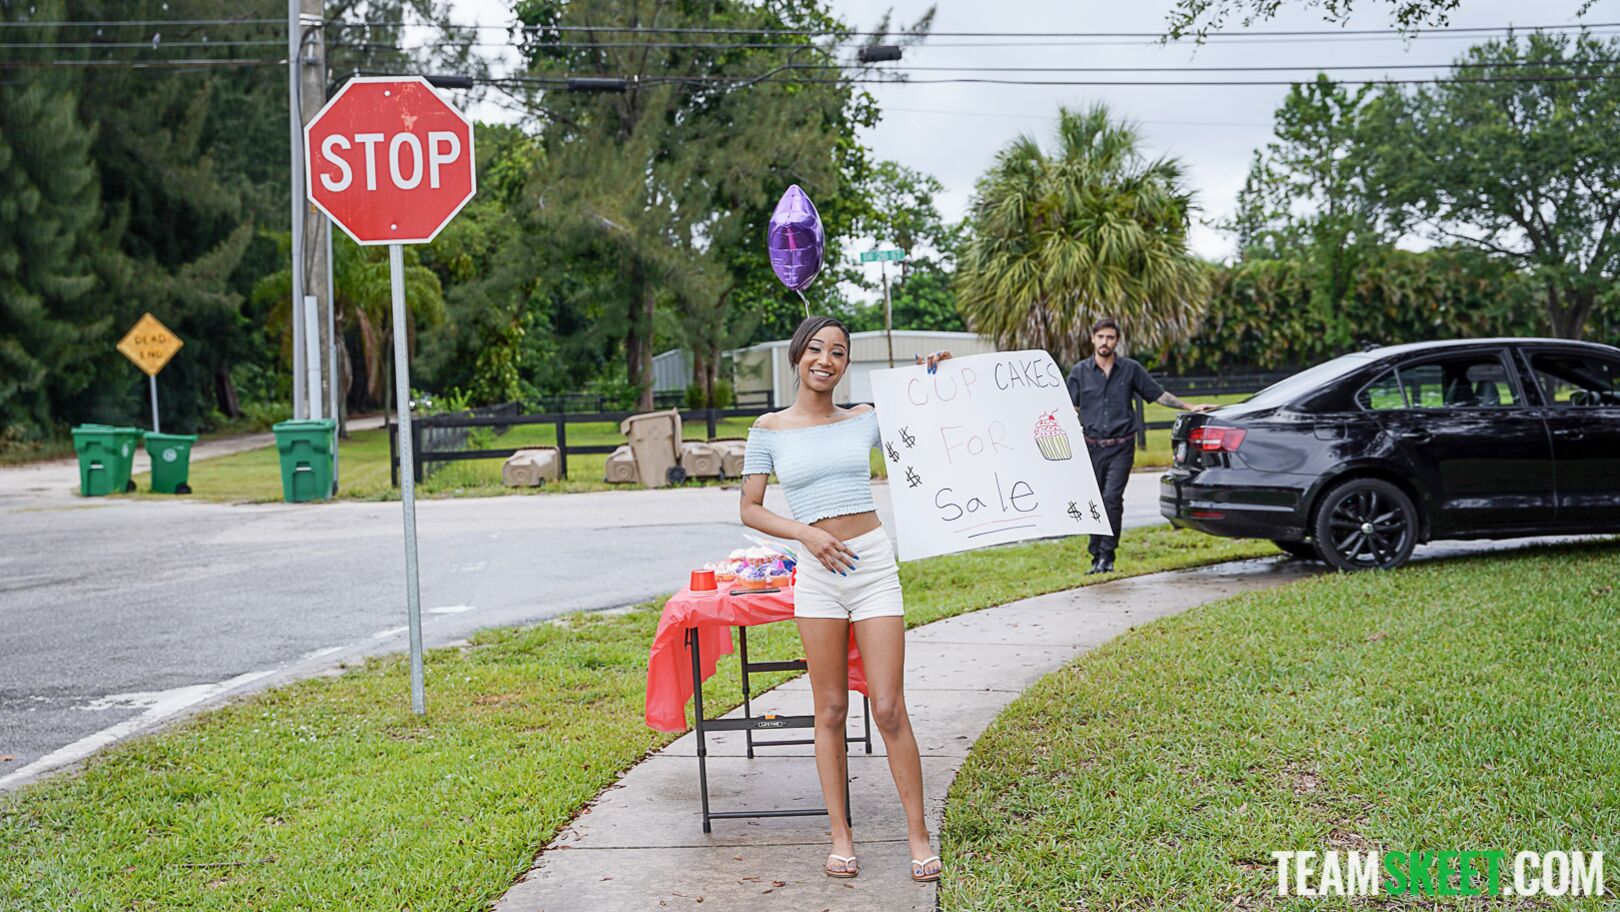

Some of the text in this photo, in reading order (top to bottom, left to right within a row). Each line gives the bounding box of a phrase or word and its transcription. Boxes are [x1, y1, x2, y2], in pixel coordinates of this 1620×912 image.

[320, 131, 461, 192] STOP
[134, 333, 166, 345] DEAD
[139, 348, 164, 360] END
[906, 358, 1061, 406] CUP CAKES
[934, 472, 1039, 521] Sale
